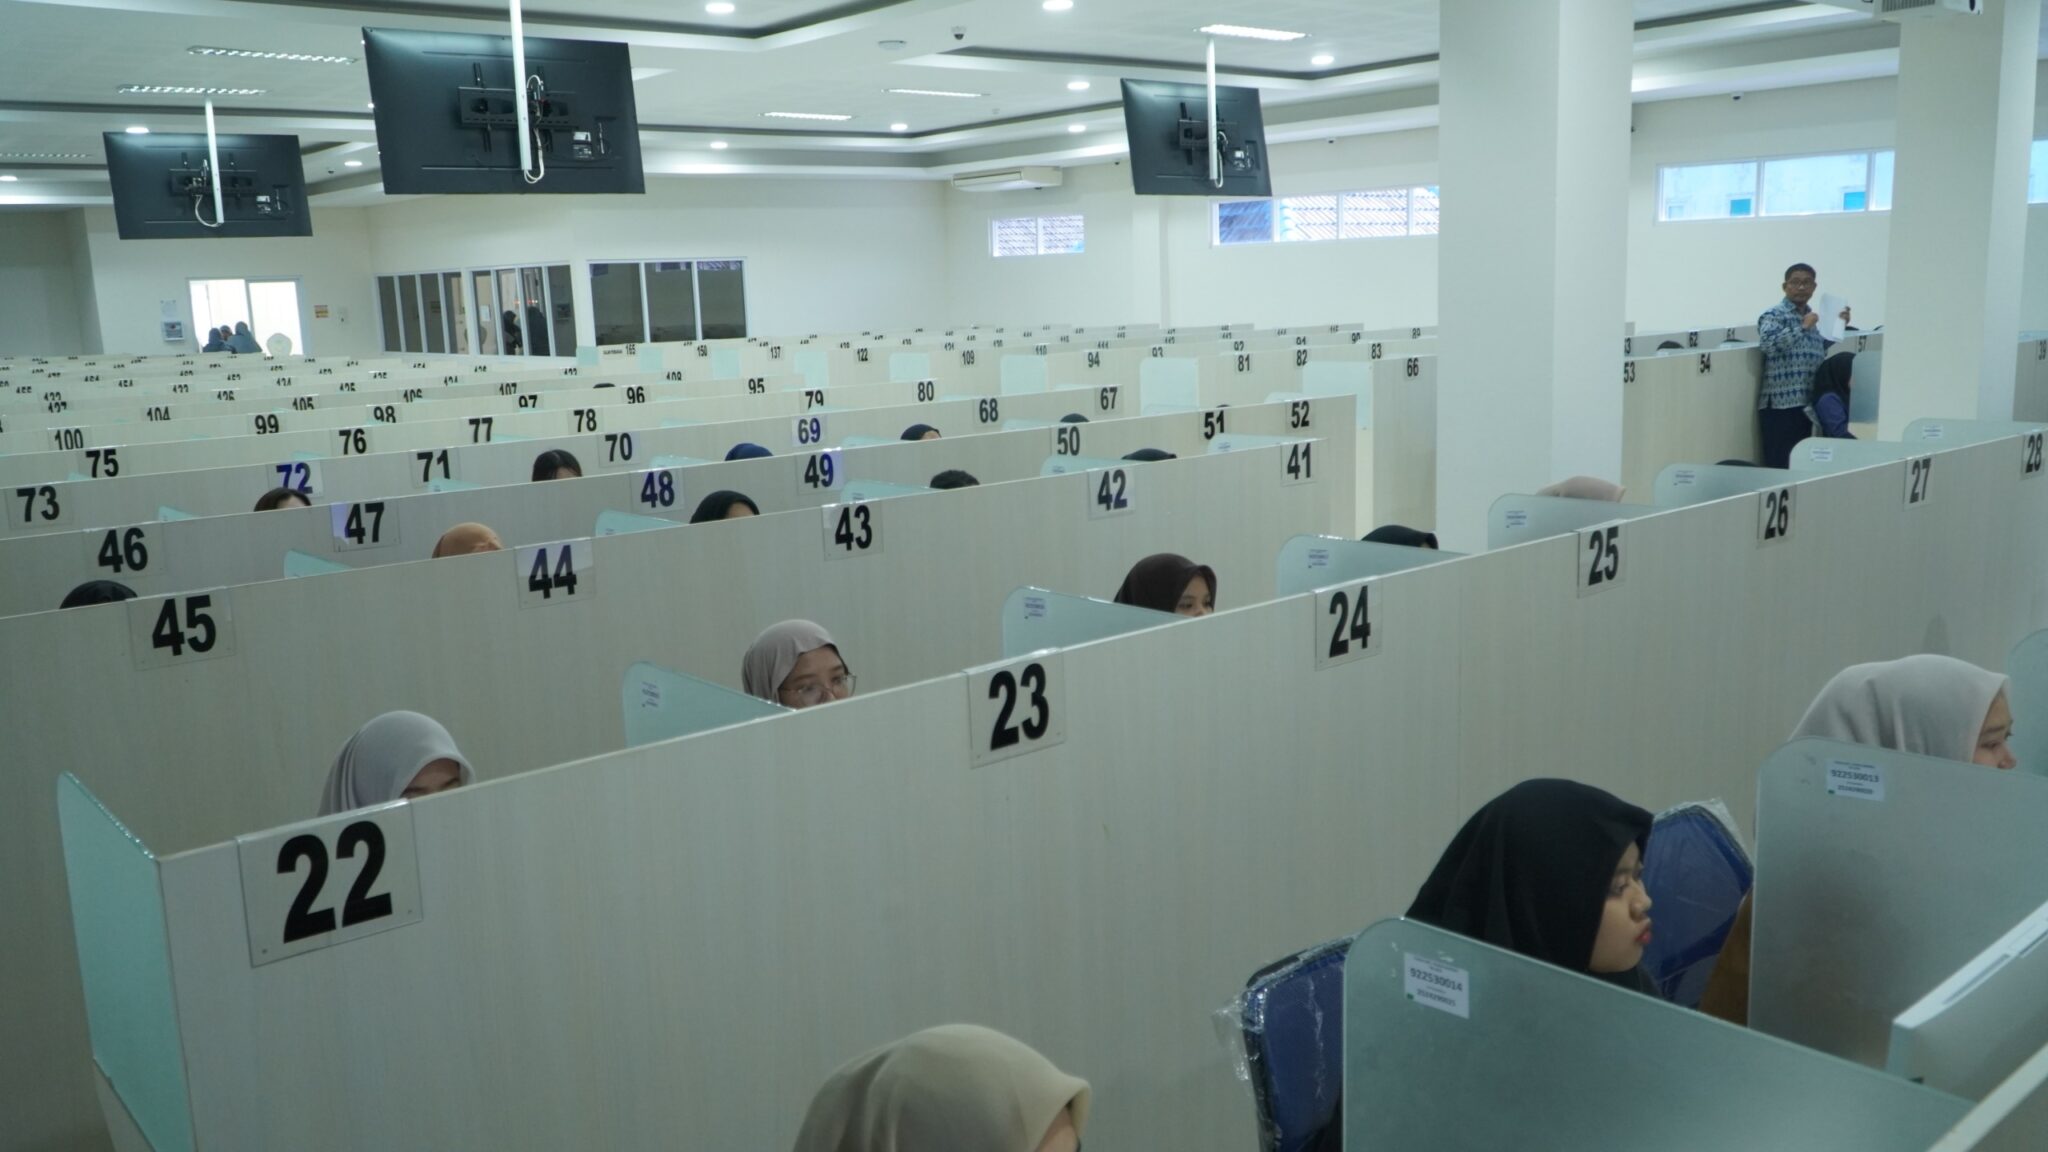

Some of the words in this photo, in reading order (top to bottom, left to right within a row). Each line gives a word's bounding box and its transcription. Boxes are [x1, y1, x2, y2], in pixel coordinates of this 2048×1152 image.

[1371, 344, 1381, 359] 83
[1689, 331, 1698, 347] 62
[857, 347, 868, 361] 122
[962, 350, 975, 365] 109
[1087, 352, 1100, 368] 94
[1237, 354, 1249, 372] 81
[1296, 350, 1307, 366] 82
[1700, 352, 1711, 373] 54
[1407, 358, 1419, 377] 66
[1624, 361, 1636, 383] 53
[499, 383, 517, 395] 107
[626, 386, 645, 404] 96
[748, 378, 765, 394] 95
[918, 381, 934, 402] 80
[1100, 387, 1118, 410] 67
[293, 397, 314, 410] 105
[518, 395, 538, 408] 97
[805, 390, 824, 409] 79
[979, 398, 999, 423] 68
[147, 406, 170, 421] 104
[255, 414, 279, 434] 99
[374, 405, 396, 423] 98
[573, 409, 597, 432] 78
[1204, 411, 1226, 440] 51
[1291, 401, 1310, 428] 52
[55, 428, 83, 450] 100
[338, 428, 366, 455] 76
[468, 417, 493, 442] 77
[798, 418, 820, 444] 69
[1057, 426, 1081, 456] 50
[604, 433, 633, 462] 70
[2025, 433, 2043, 473] 28
[85, 449, 119, 478] 75
[417, 450, 451, 482] 71
[804, 454, 834, 488] 49
[1287, 443, 1312, 479] 41
[276, 462, 313, 494] 72
[641, 470, 675, 508] 48
[1097, 469, 1128, 510] 42
[1909, 458, 1931, 503] 27
[16, 485, 60, 522] 73
[1764, 489, 1789, 540] 26
[345, 502, 385, 544] 47
[835, 505, 872, 551] 43
[98, 527, 149, 573] 46
[1588, 526, 1619, 586] 25
[528, 544, 577, 599] 44
[152, 594, 217, 656] 45
[1328, 585, 1371, 658] 24
[988, 663, 1050, 751] 23
[276, 819, 394, 944] 22
[1409, 966, 1464, 992] 922530014
